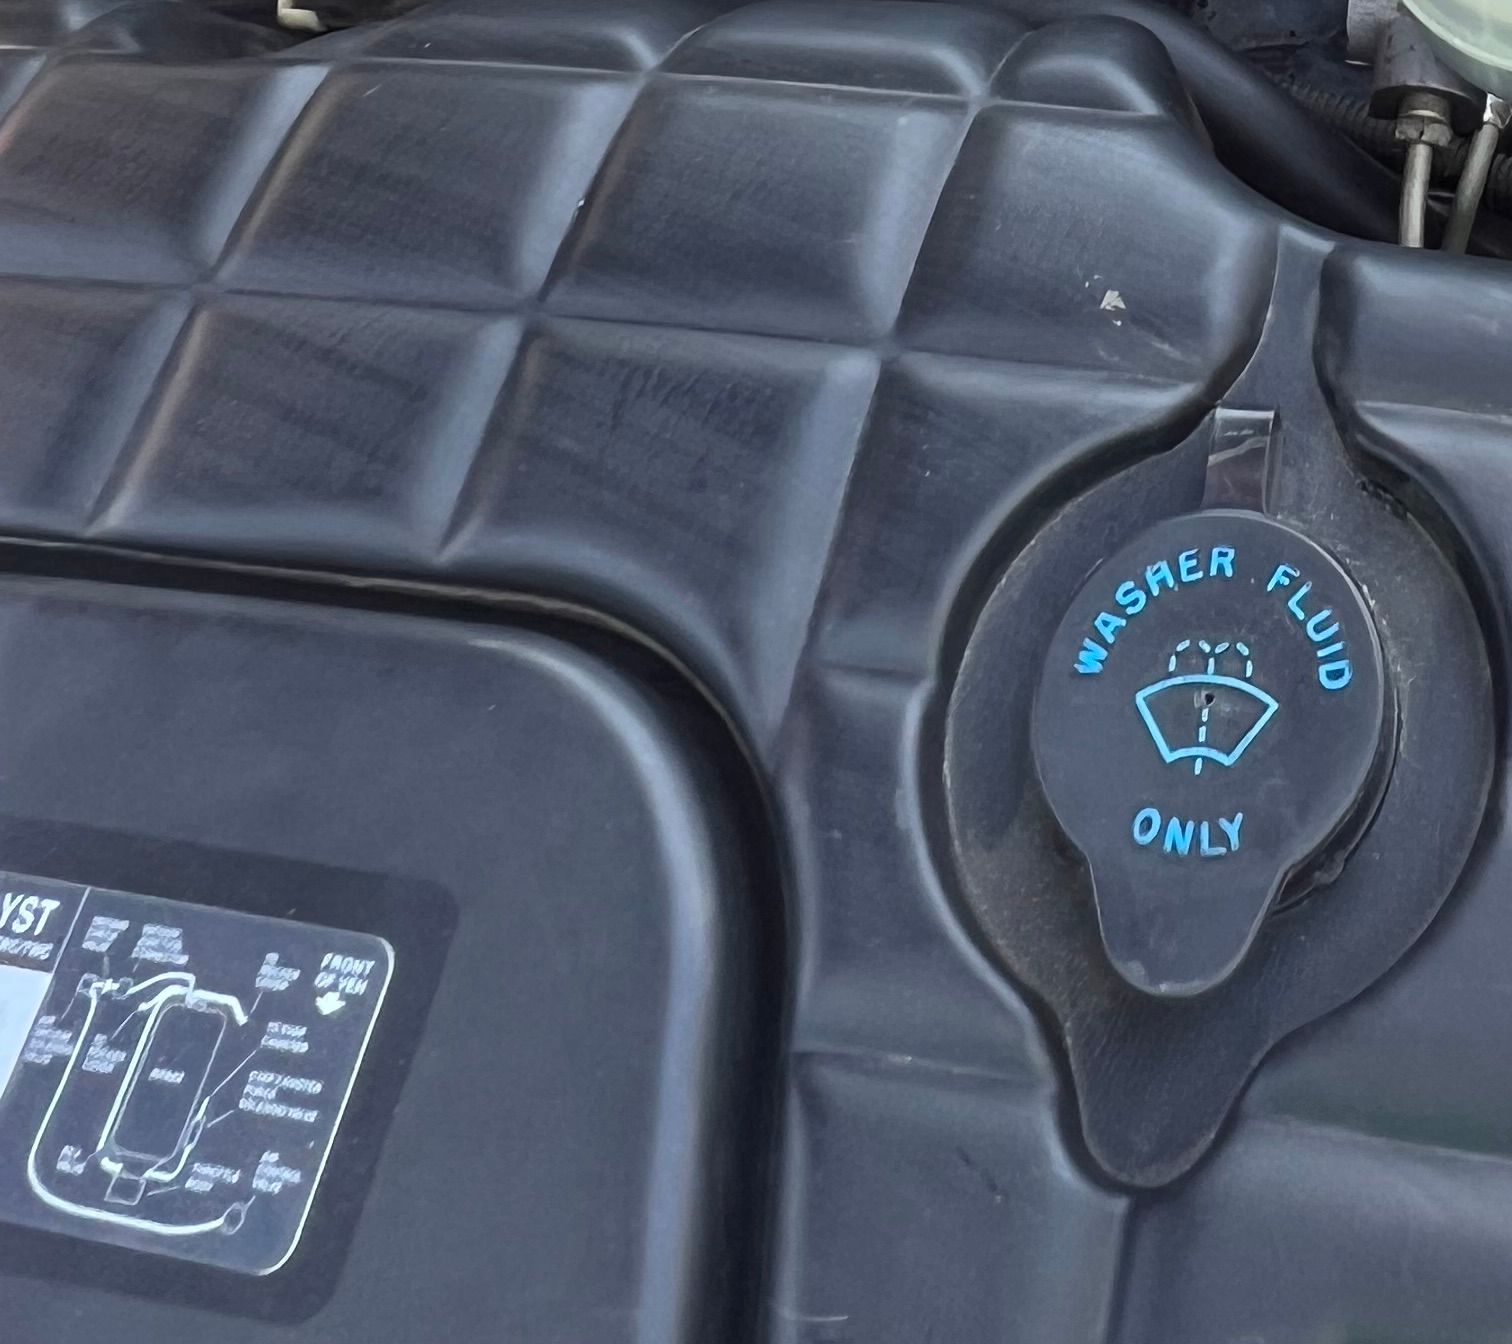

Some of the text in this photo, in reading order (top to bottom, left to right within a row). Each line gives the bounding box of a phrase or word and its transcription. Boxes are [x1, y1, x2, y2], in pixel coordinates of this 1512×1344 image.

[1073, 544, 1354, 691] WASHER FLUID
[1132, 807, 1244, 857] ONLY
